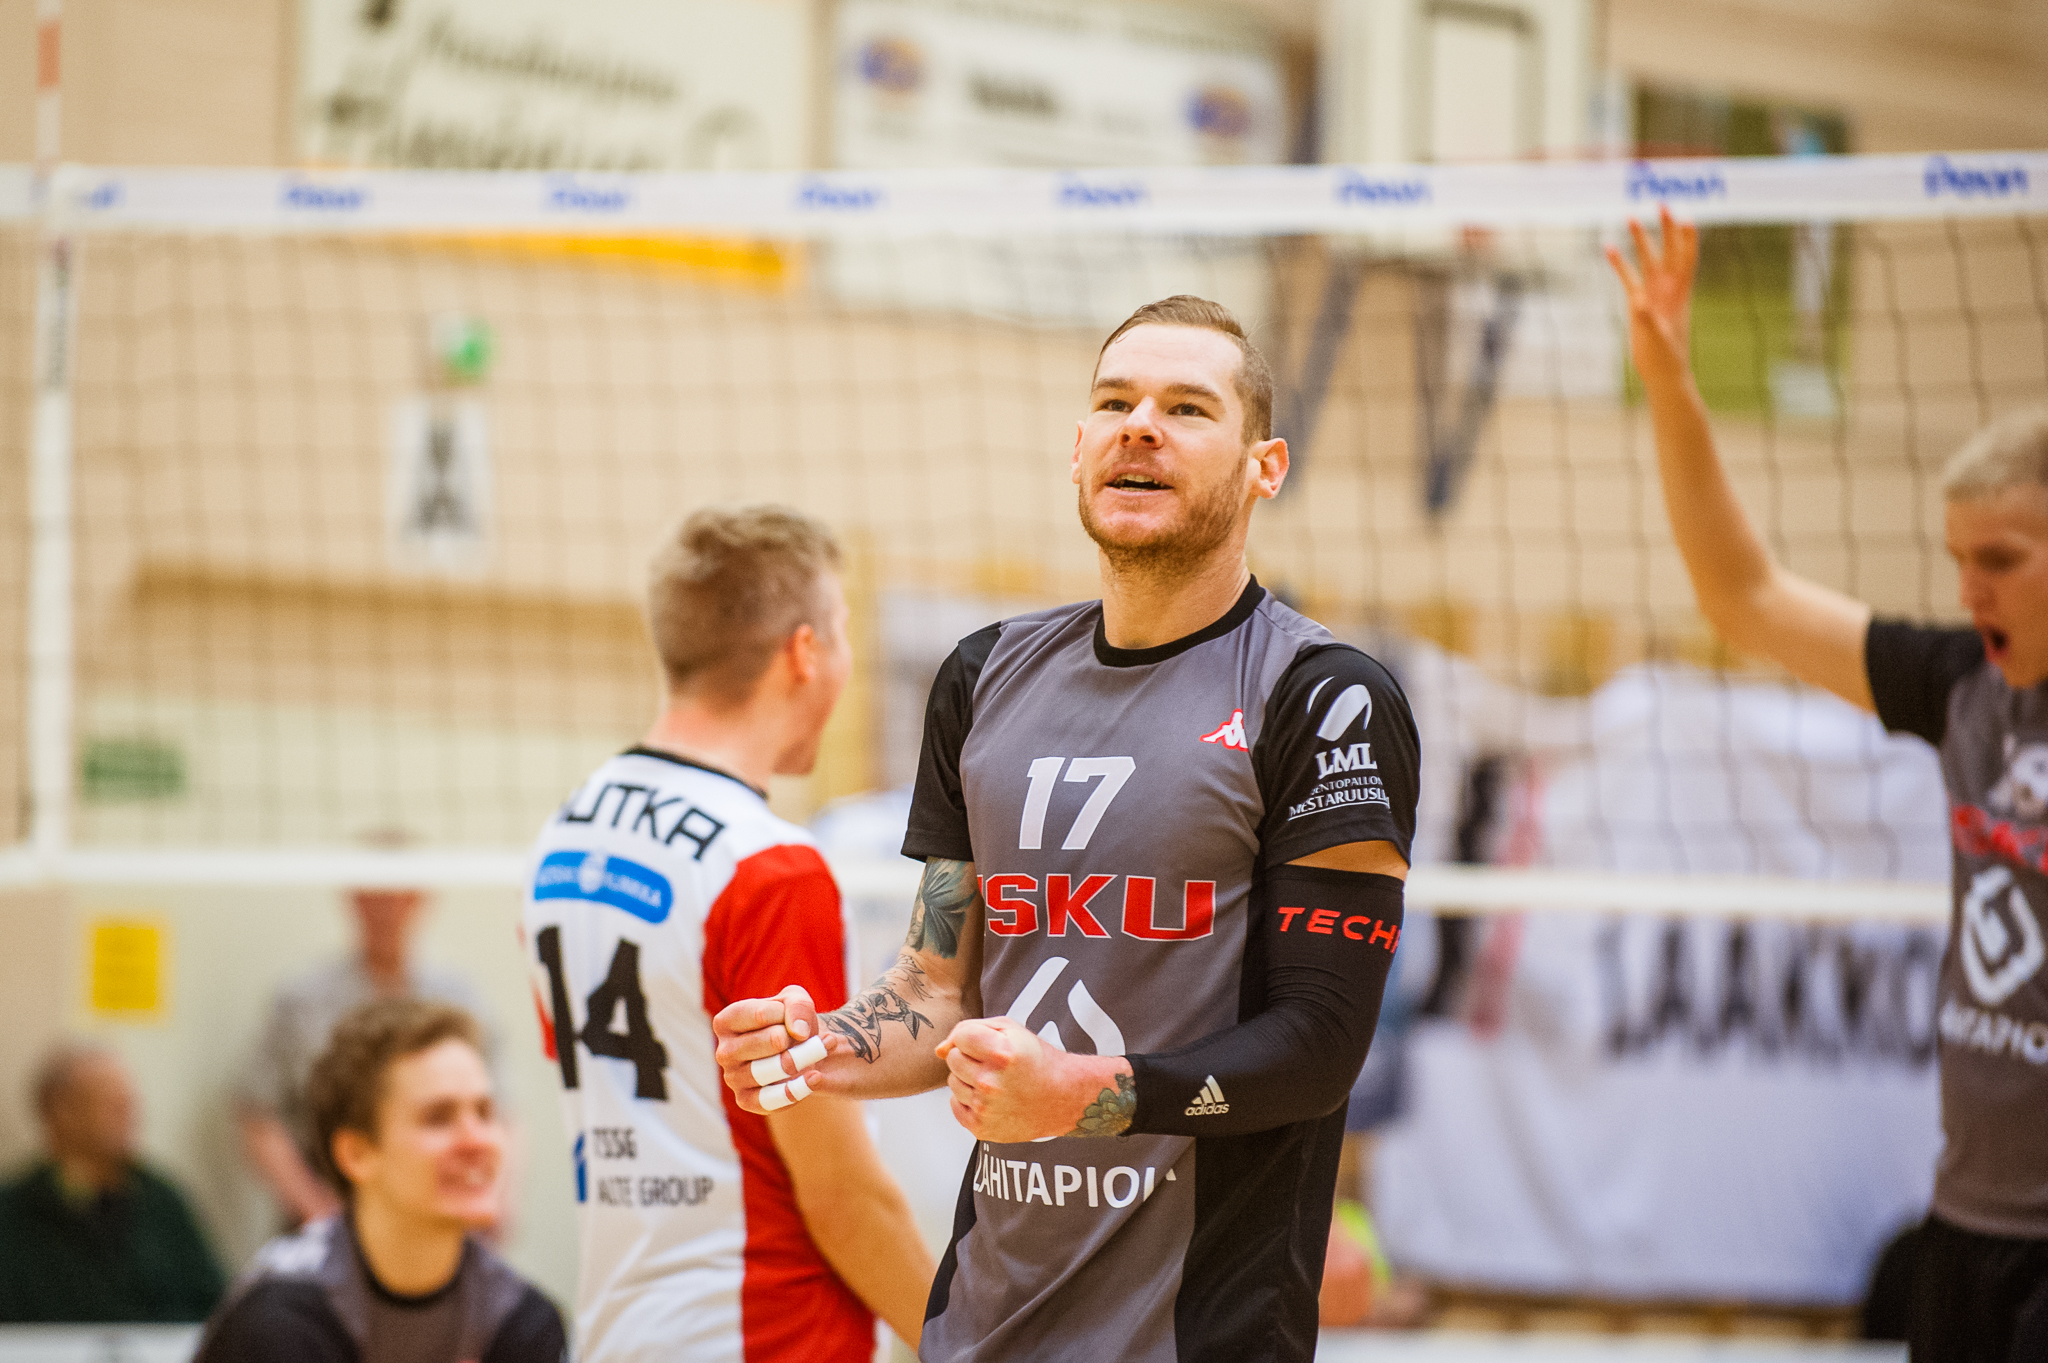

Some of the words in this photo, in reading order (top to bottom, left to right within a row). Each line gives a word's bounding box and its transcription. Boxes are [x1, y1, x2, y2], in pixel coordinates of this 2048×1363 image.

[1315, 743, 1378, 779] LML
[1018, 756, 1137, 850] 17
[1277, 906, 1401, 954] TECH
[536, 925, 669, 1102] 14
[1184, 1102, 1230, 1117] adidas
[639, 1175, 715, 1207] GROUP
[973, 1143, 1177, 1209] LÄHITAPIO
